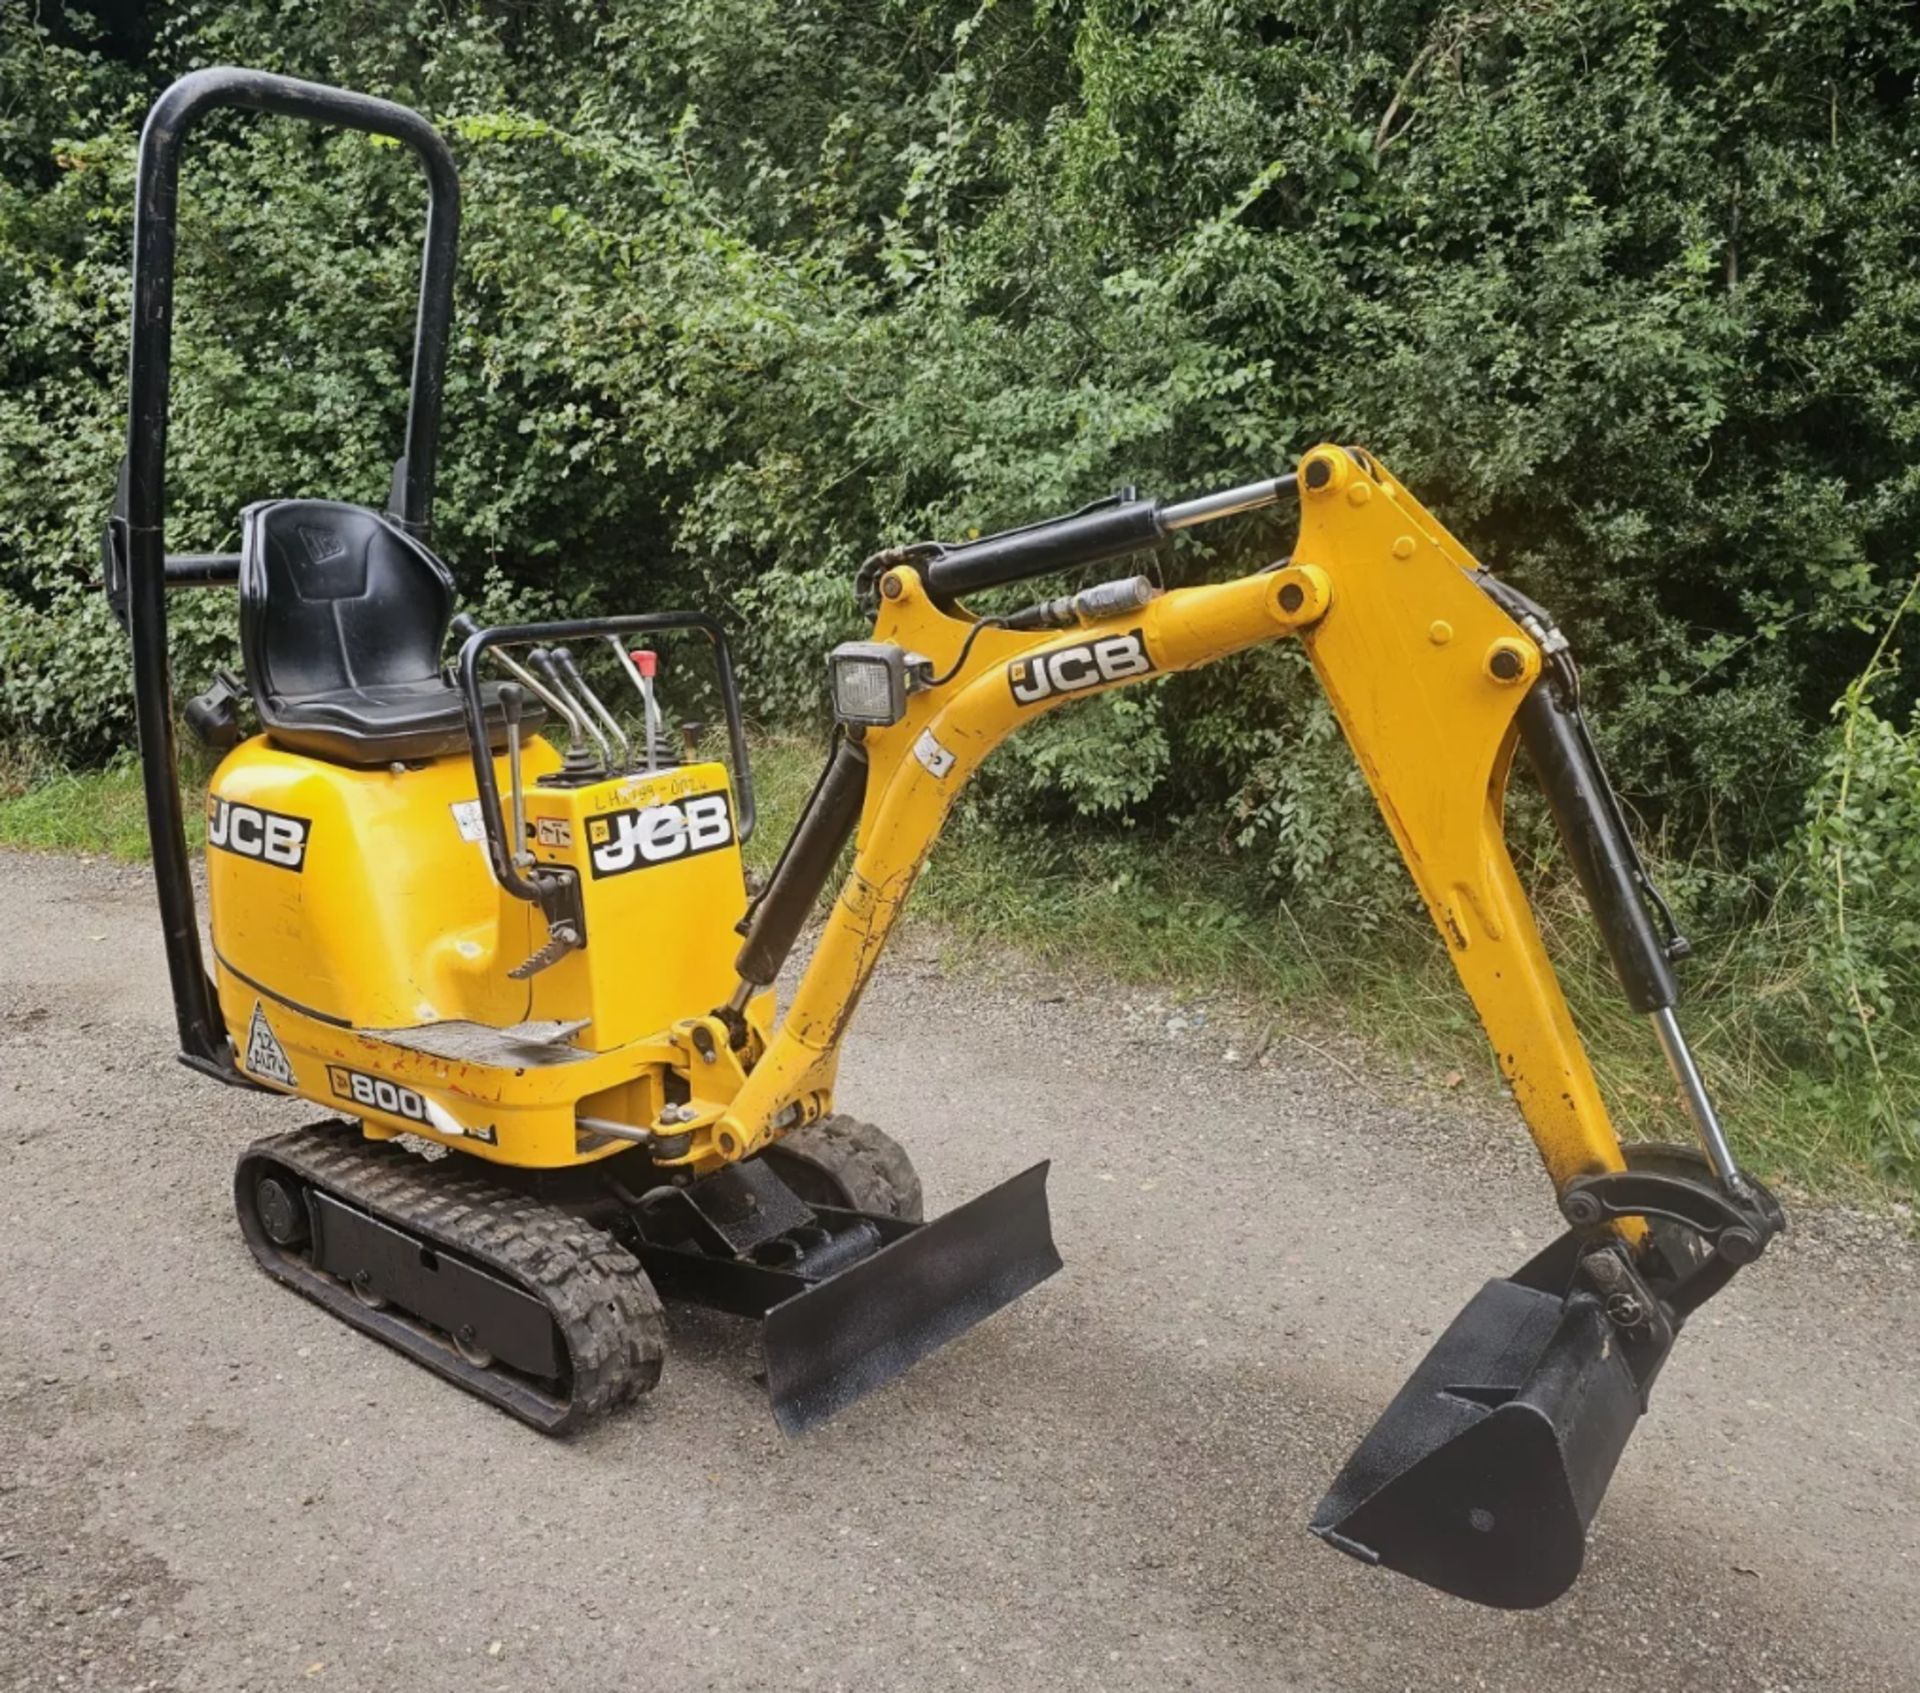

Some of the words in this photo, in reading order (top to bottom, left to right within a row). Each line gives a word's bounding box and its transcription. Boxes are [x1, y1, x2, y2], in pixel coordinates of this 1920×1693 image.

[1012, 635, 1150, 702] JCB
[208, 801, 304, 867] JCB
[593, 795, 731, 872] JCB
